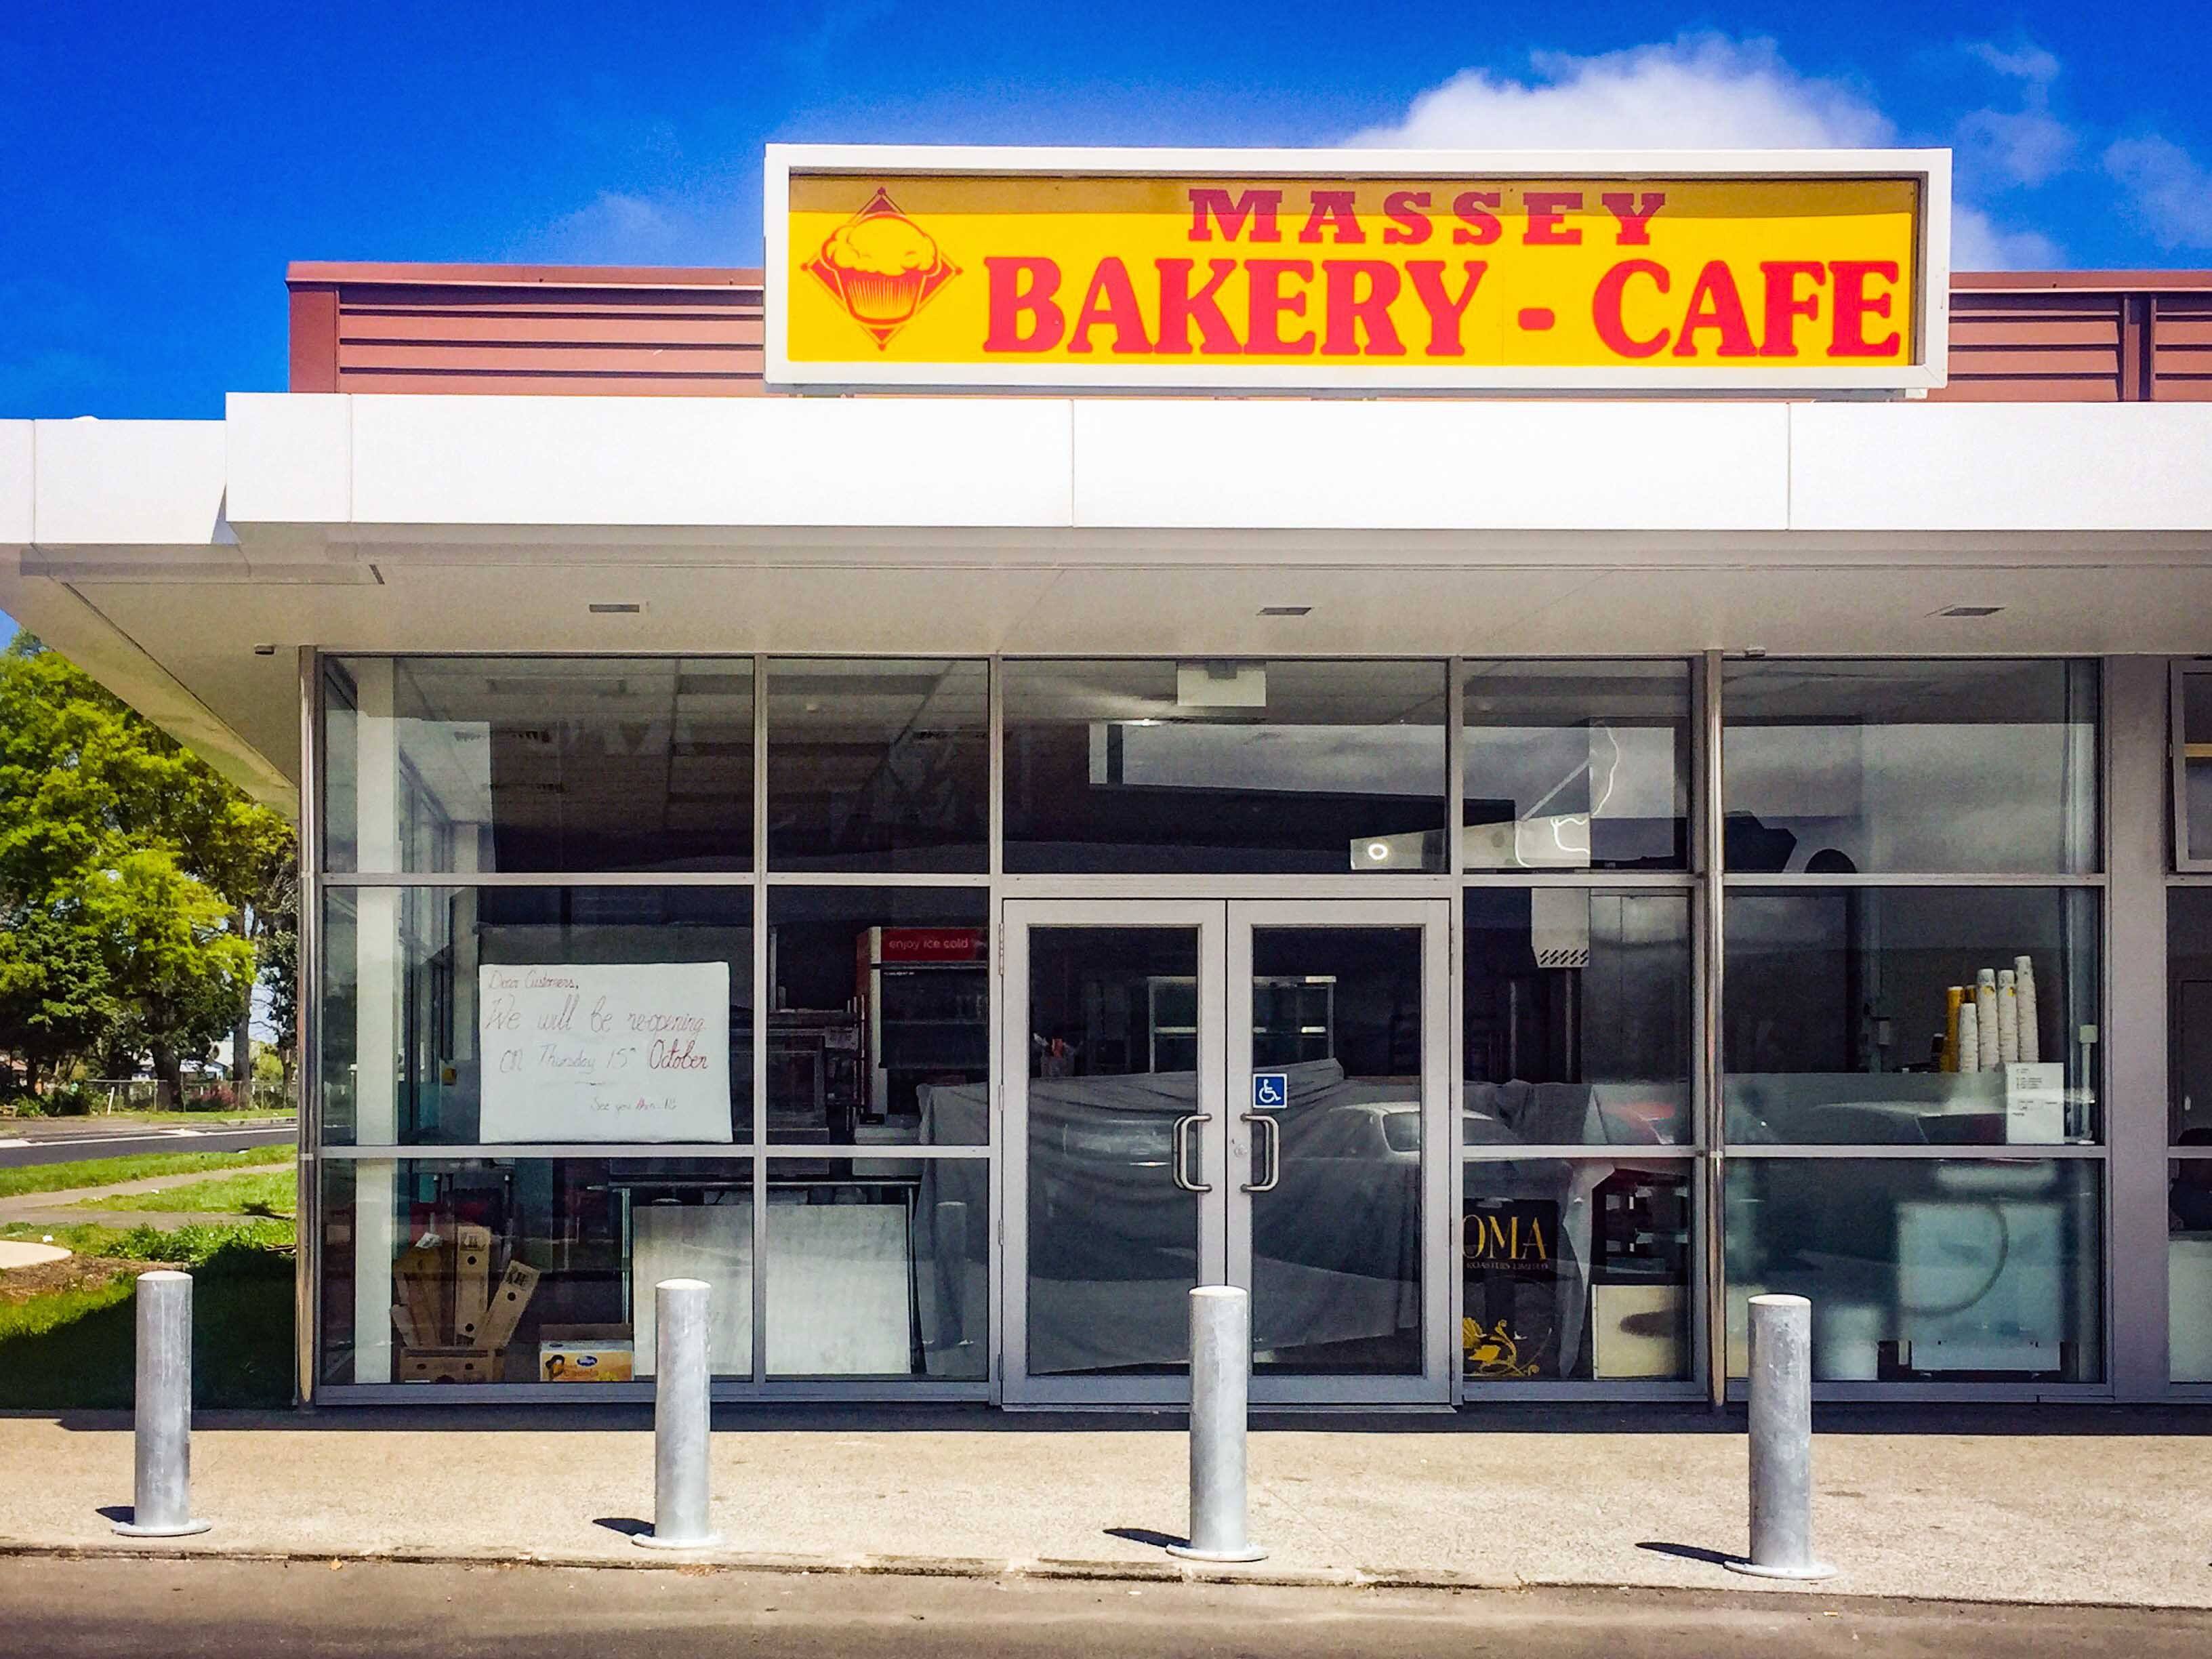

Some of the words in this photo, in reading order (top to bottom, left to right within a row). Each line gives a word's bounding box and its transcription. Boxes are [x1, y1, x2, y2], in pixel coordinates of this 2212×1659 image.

[1189, 188, 1666, 245] MASSEY
[983, 258, 1488, 355] BAKERY
[1517, 307, 1555, 331] -
[1592, 260, 1901, 358] CAFE
[888, 939, 920, 950] enjoy
[923, 938, 941, 949] ice
[943, 937, 968, 949] cold
[484, 993, 521, 1030] We
[537, 993, 580, 1031] will
[591, 996, 613, 1033] be
[650, 1038, 709, 1069] October
[1462, 1214, 1547, 1260] OMA
